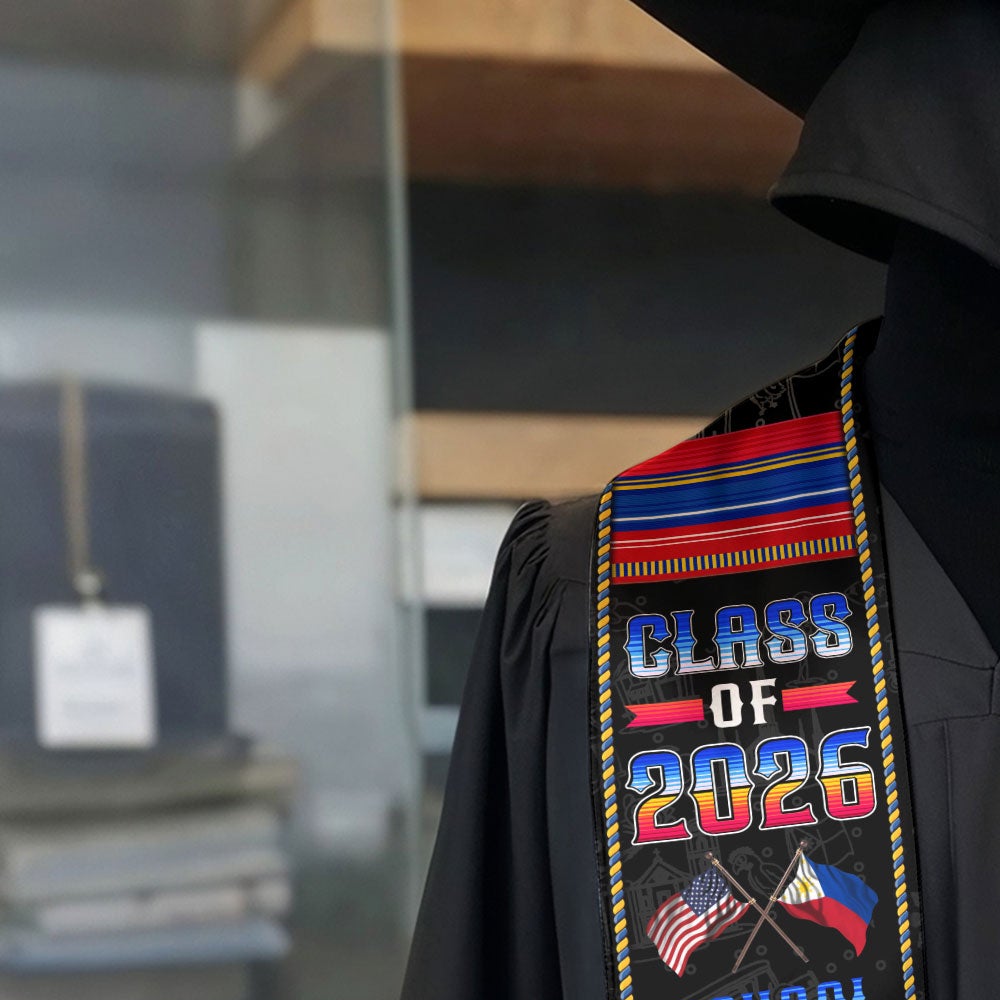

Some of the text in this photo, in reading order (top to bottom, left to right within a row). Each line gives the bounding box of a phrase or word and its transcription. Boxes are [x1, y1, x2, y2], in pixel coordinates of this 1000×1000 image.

[623, 592, 853, 678] CLASS
[709, 678, 777, 728] OF
[625, 726, 877, 845] 2026
